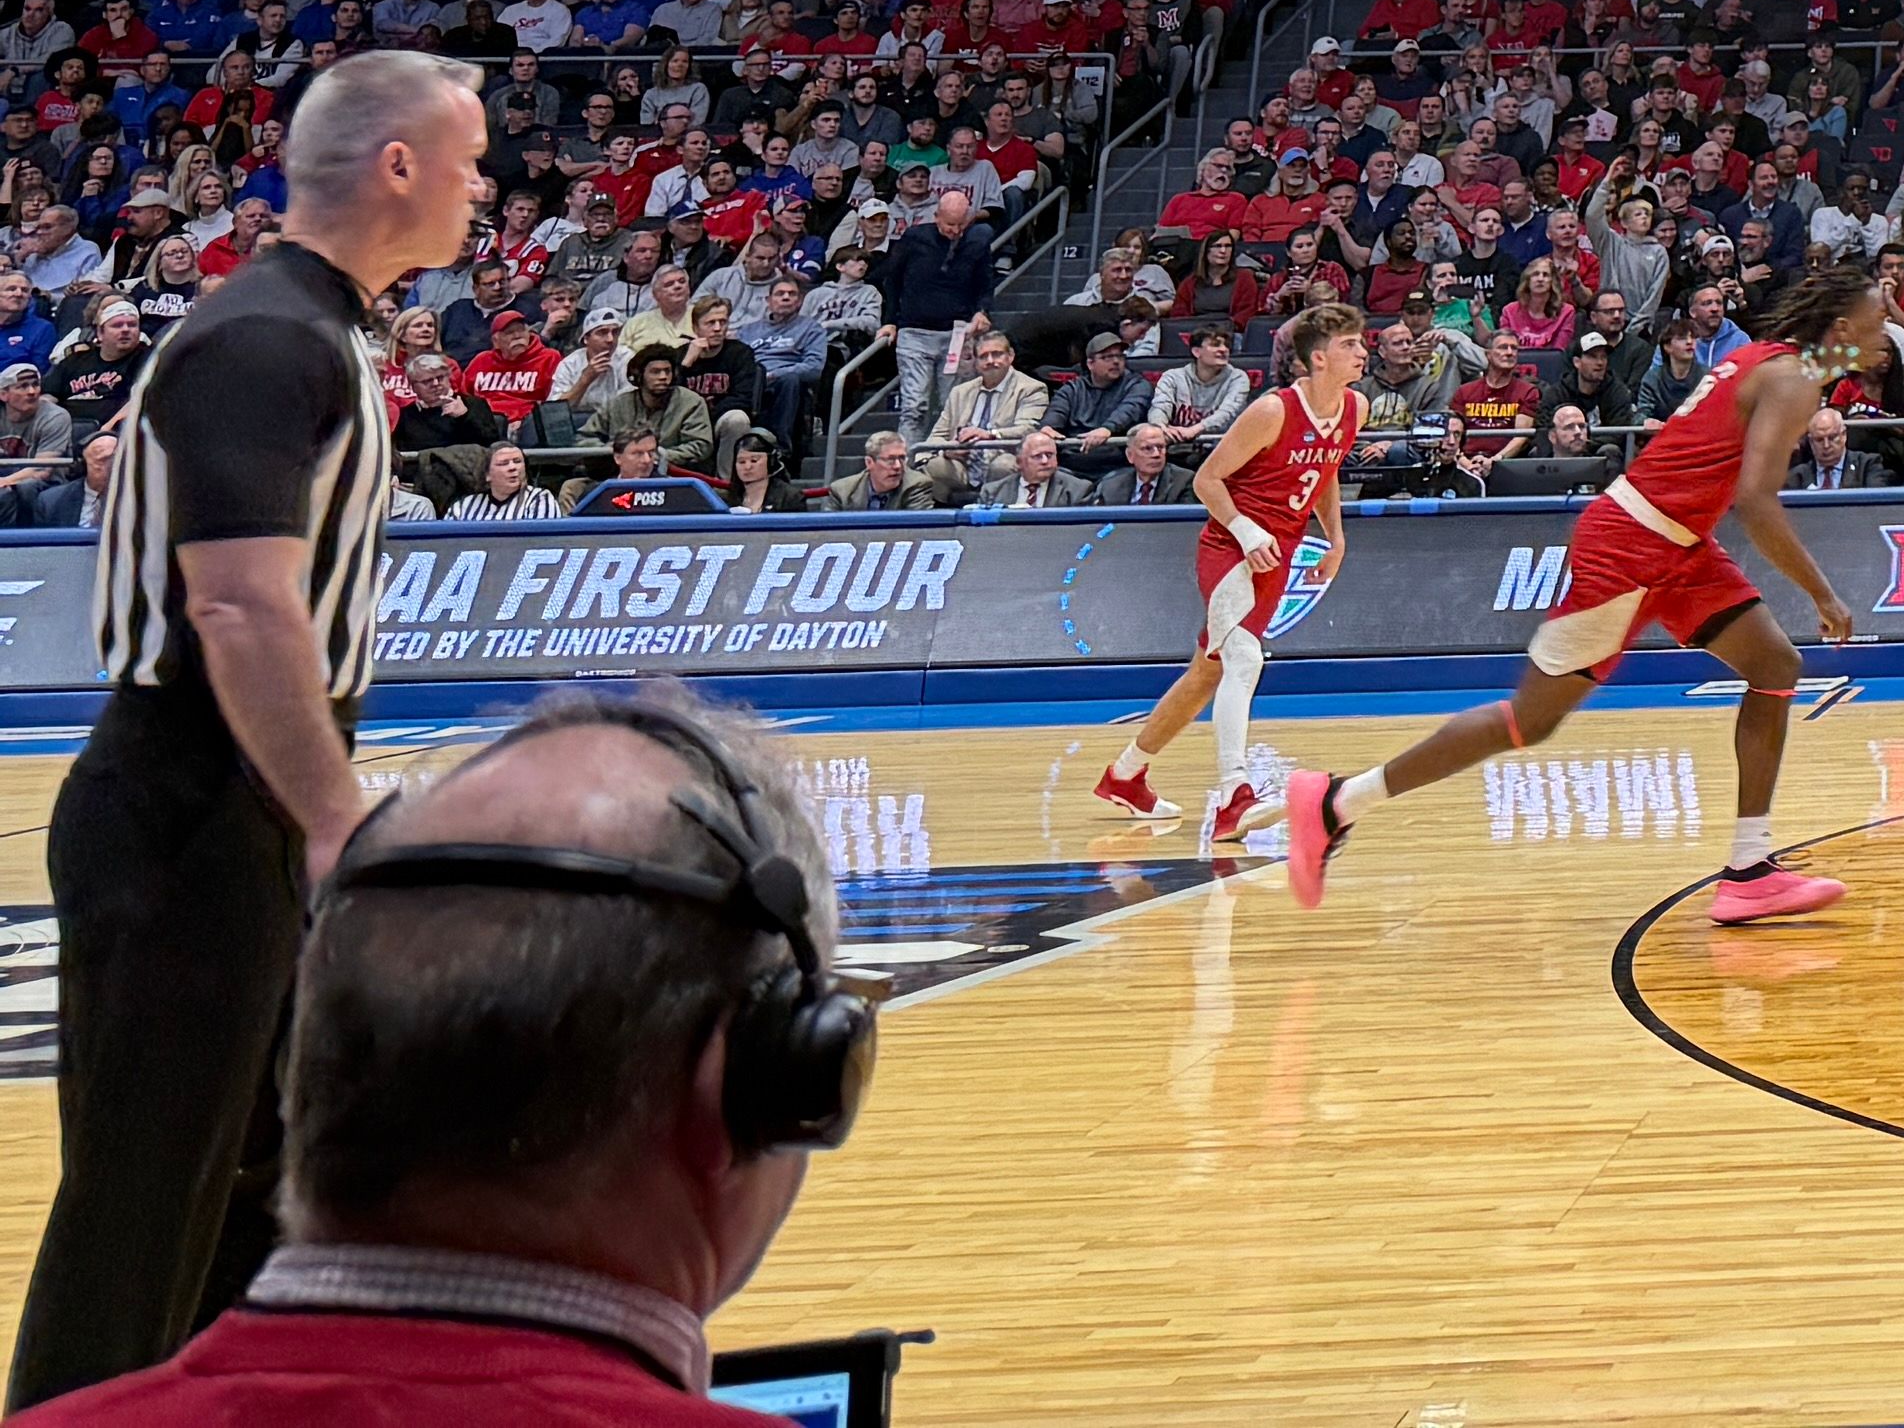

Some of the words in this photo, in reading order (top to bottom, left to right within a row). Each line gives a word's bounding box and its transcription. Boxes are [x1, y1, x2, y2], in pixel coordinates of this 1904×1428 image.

[474, 369, 538, 393] MIAMI
[633, 490, 666, 508] POSS
[1288, 469, 1321, 512] 3
[495, 546, 744, 622] FIRST
[743, 539, 964, 616] FOUR
[432, 629, 480, 660] BY
[481, 627, 543, 659] THE
[542, 623, 722, 659] UNIVERSITY
[726, 621, 768, 651] OF
[768, 619, 888, 652] DAYTON
